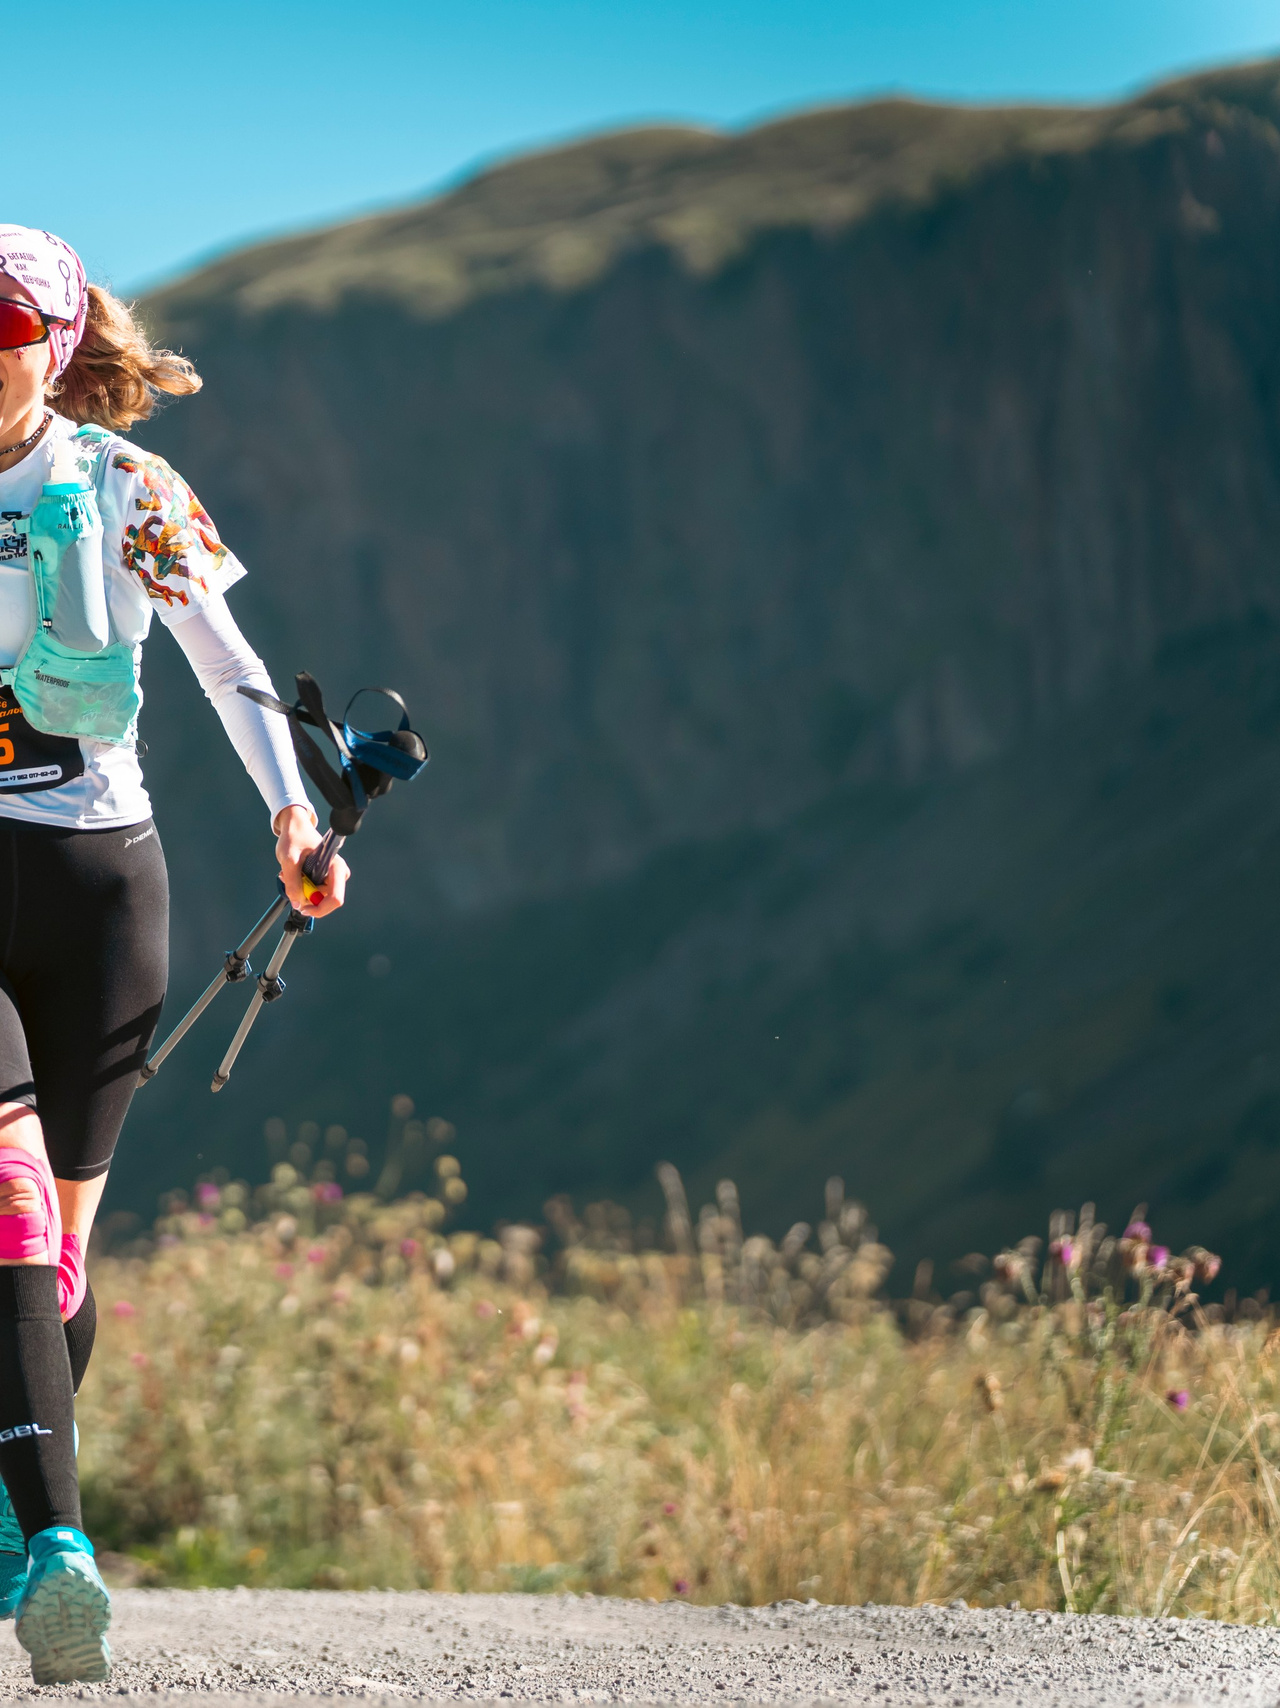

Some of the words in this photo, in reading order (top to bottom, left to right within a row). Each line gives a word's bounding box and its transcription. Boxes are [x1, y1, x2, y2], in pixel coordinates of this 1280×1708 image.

[7, 252, 38, 262] БЕГАЕШЬ
[14, 263, 29, 271] КАК
[21, 274, 52, 289] ДЕВЧОНКА
[35, 673, 70, 688] WATERPROOF
